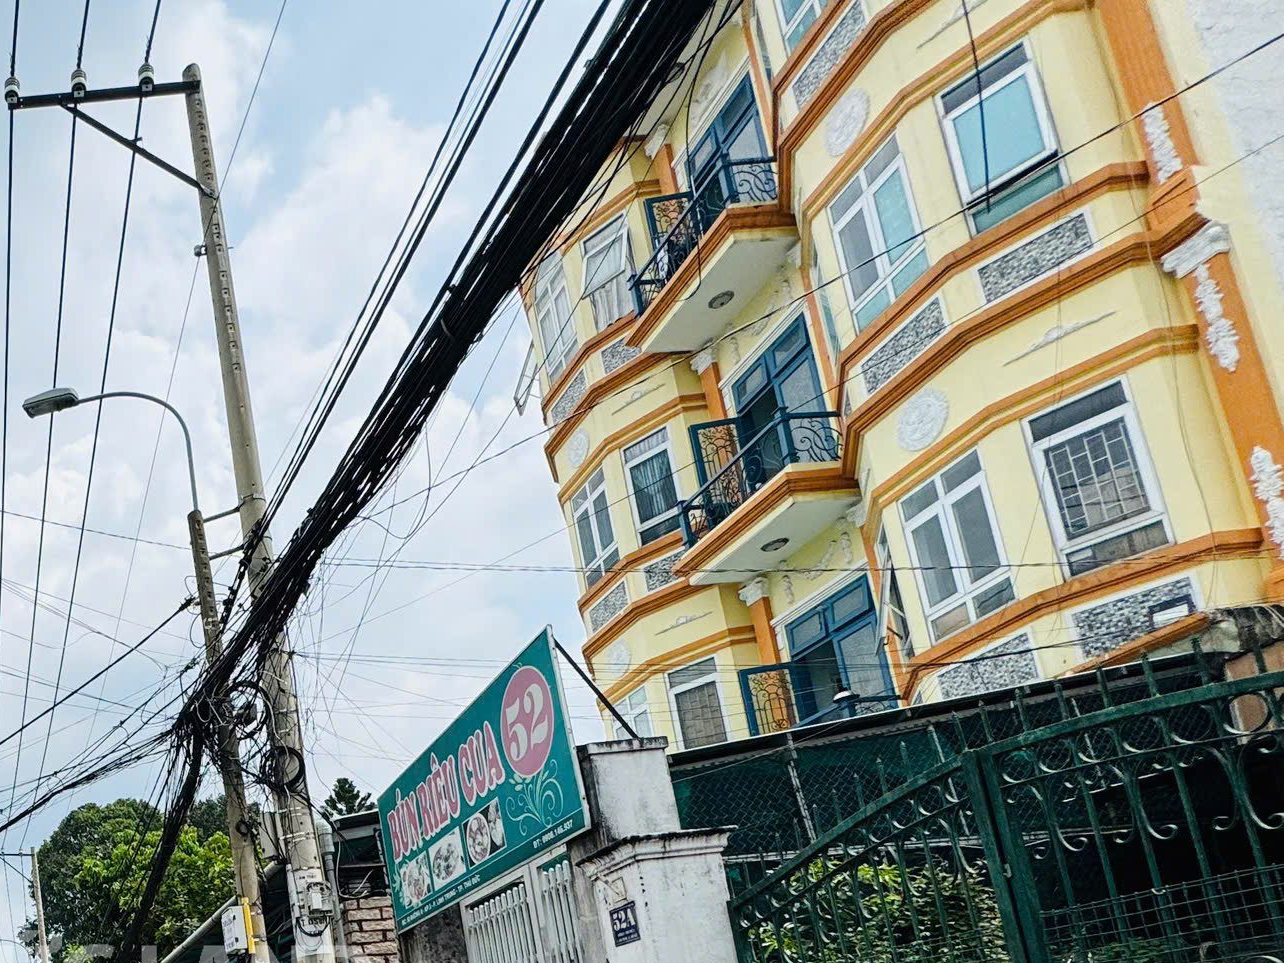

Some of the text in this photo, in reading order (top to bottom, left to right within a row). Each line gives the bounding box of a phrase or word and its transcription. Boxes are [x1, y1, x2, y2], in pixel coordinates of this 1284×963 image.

[387, 683, 549, 862] BÚN RIÊU CUA 52
[612, 908, 636, 932] 52A
